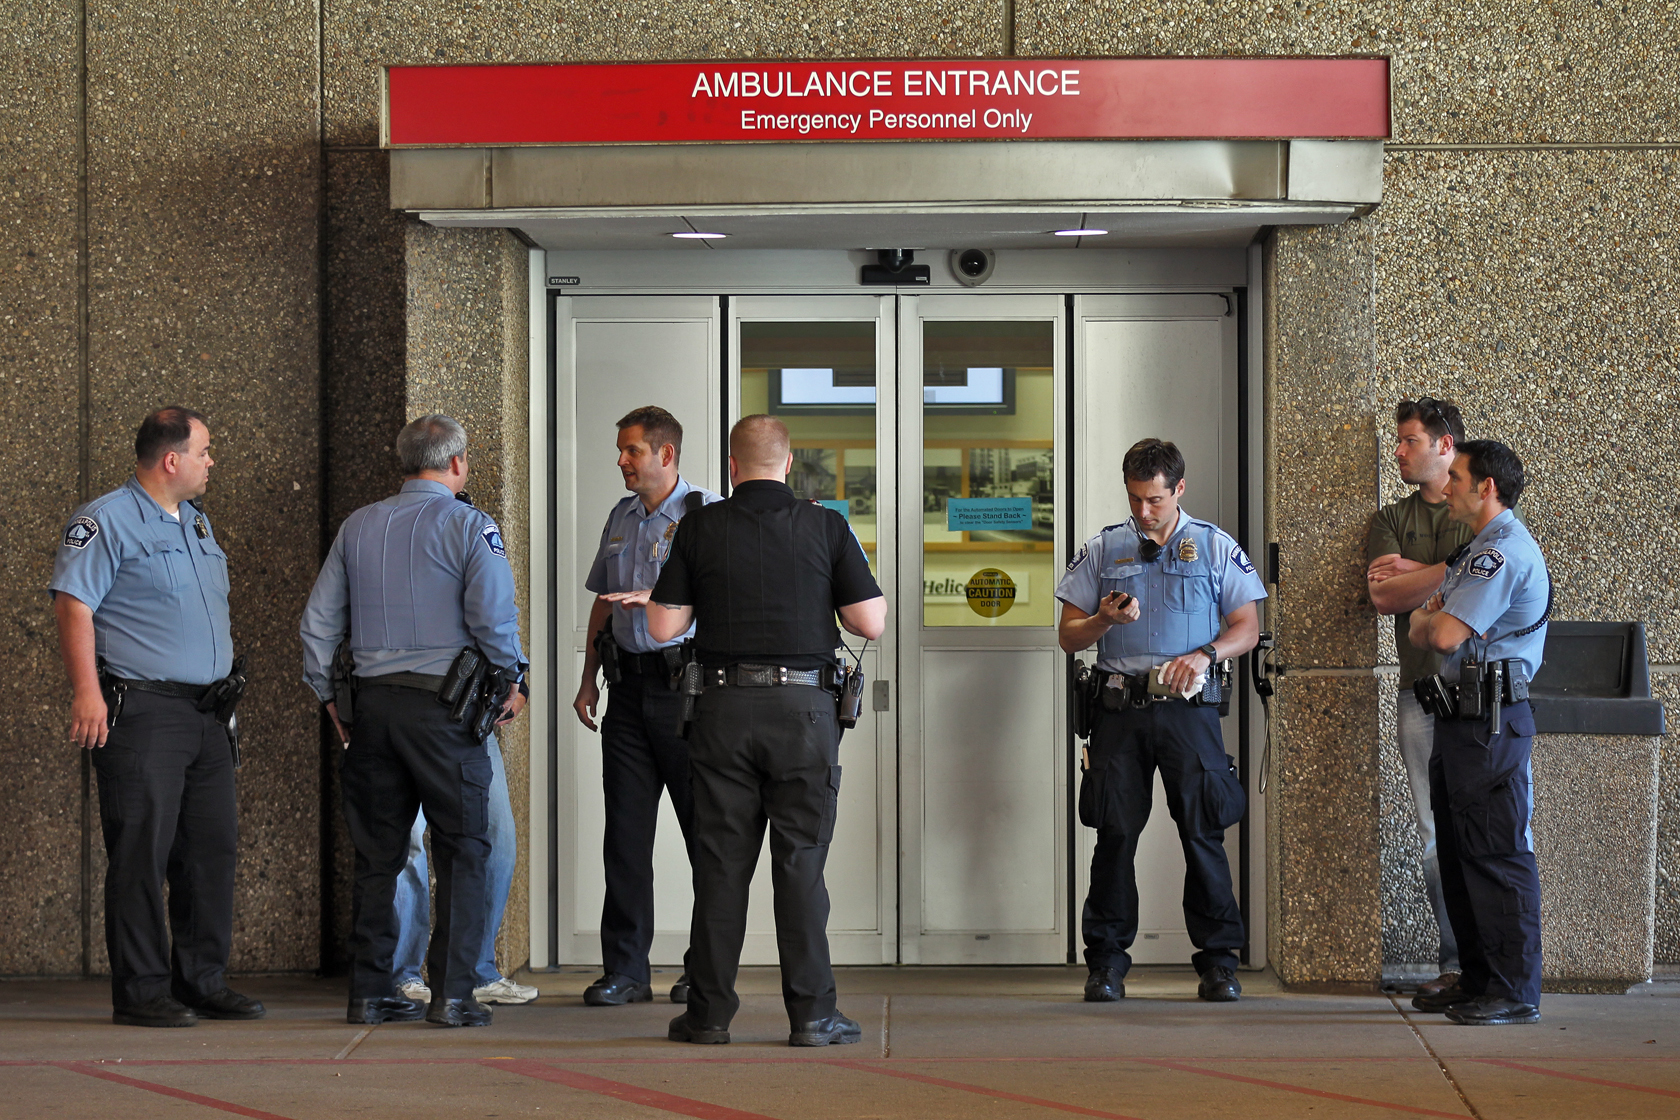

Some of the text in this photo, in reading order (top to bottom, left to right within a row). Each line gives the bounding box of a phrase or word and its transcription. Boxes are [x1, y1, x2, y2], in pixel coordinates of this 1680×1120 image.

[691, 68, 1080, 98] AMBULANCE ENTRANCE
[741, 107, 1033, 134] Emergency Personnel Only
[67, 538, 83, 546] POLICE
[1472, 568, 1490, 577] POLICE
[969, 578, 1011, 586] AUTOMATIC
[968, 588, 1013, 598] CAUTION
